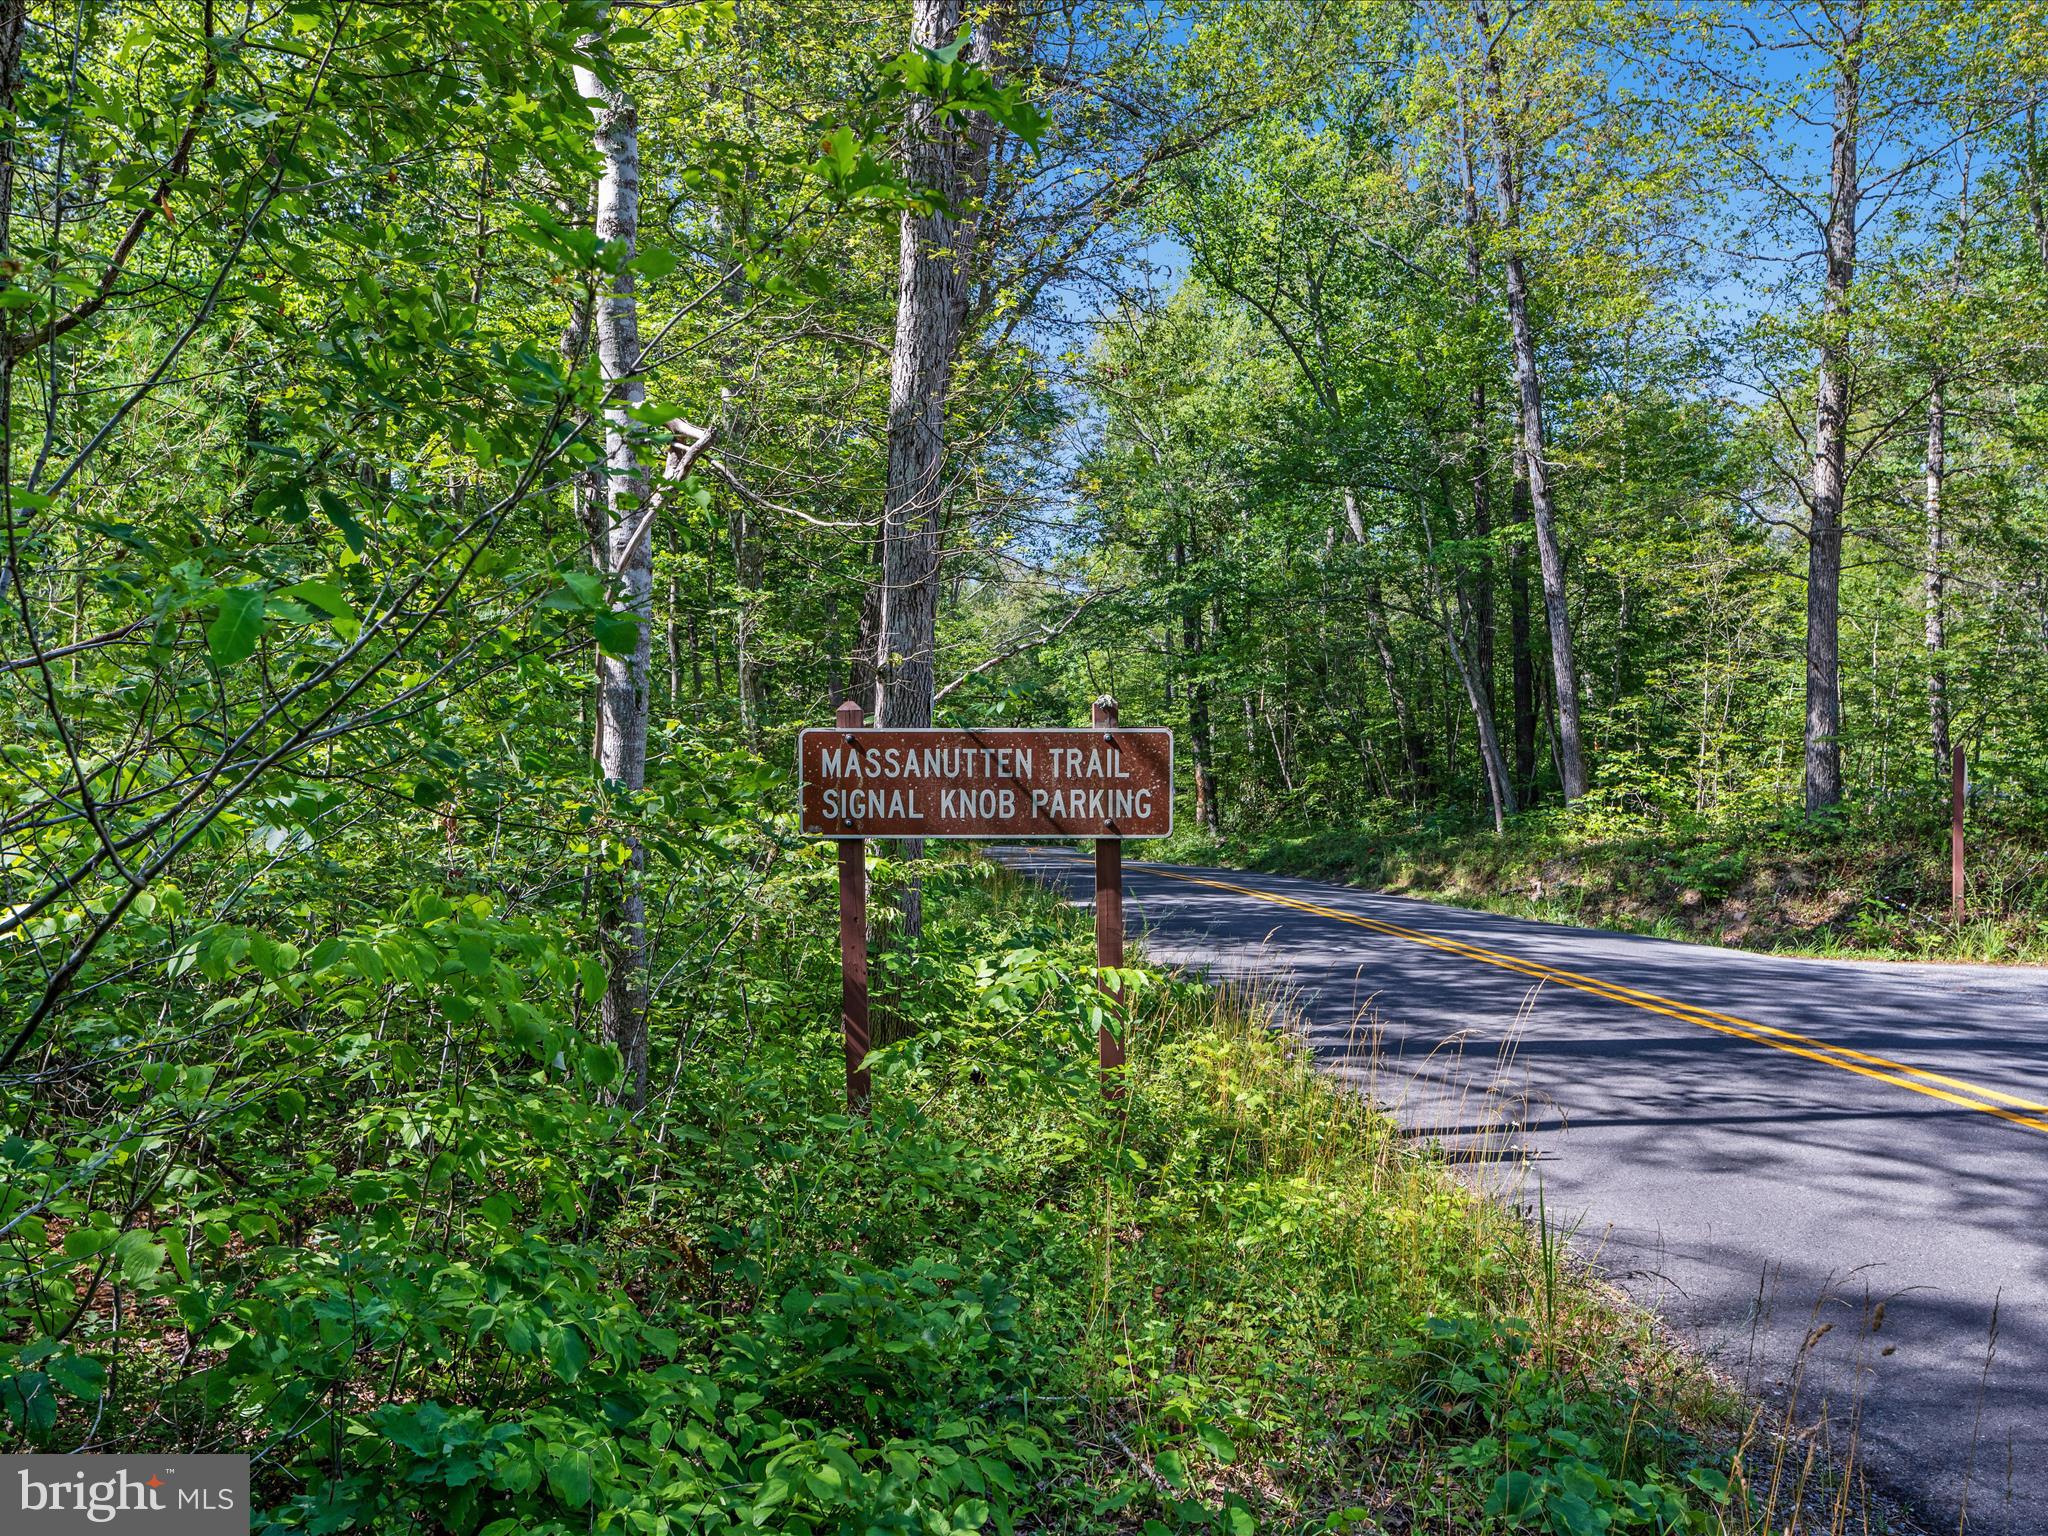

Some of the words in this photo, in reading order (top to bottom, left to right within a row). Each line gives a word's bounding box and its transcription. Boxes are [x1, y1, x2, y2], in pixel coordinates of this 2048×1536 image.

[821, 748, 1033, 779] MASSANUTTEN
[1049, 748, 1130, 779] TRAIL
[822, 789, 924, 819] SIGNAL
[940, 789, 1015, 819] KNOB
[1032, 789, 1152, 819] PARKING
